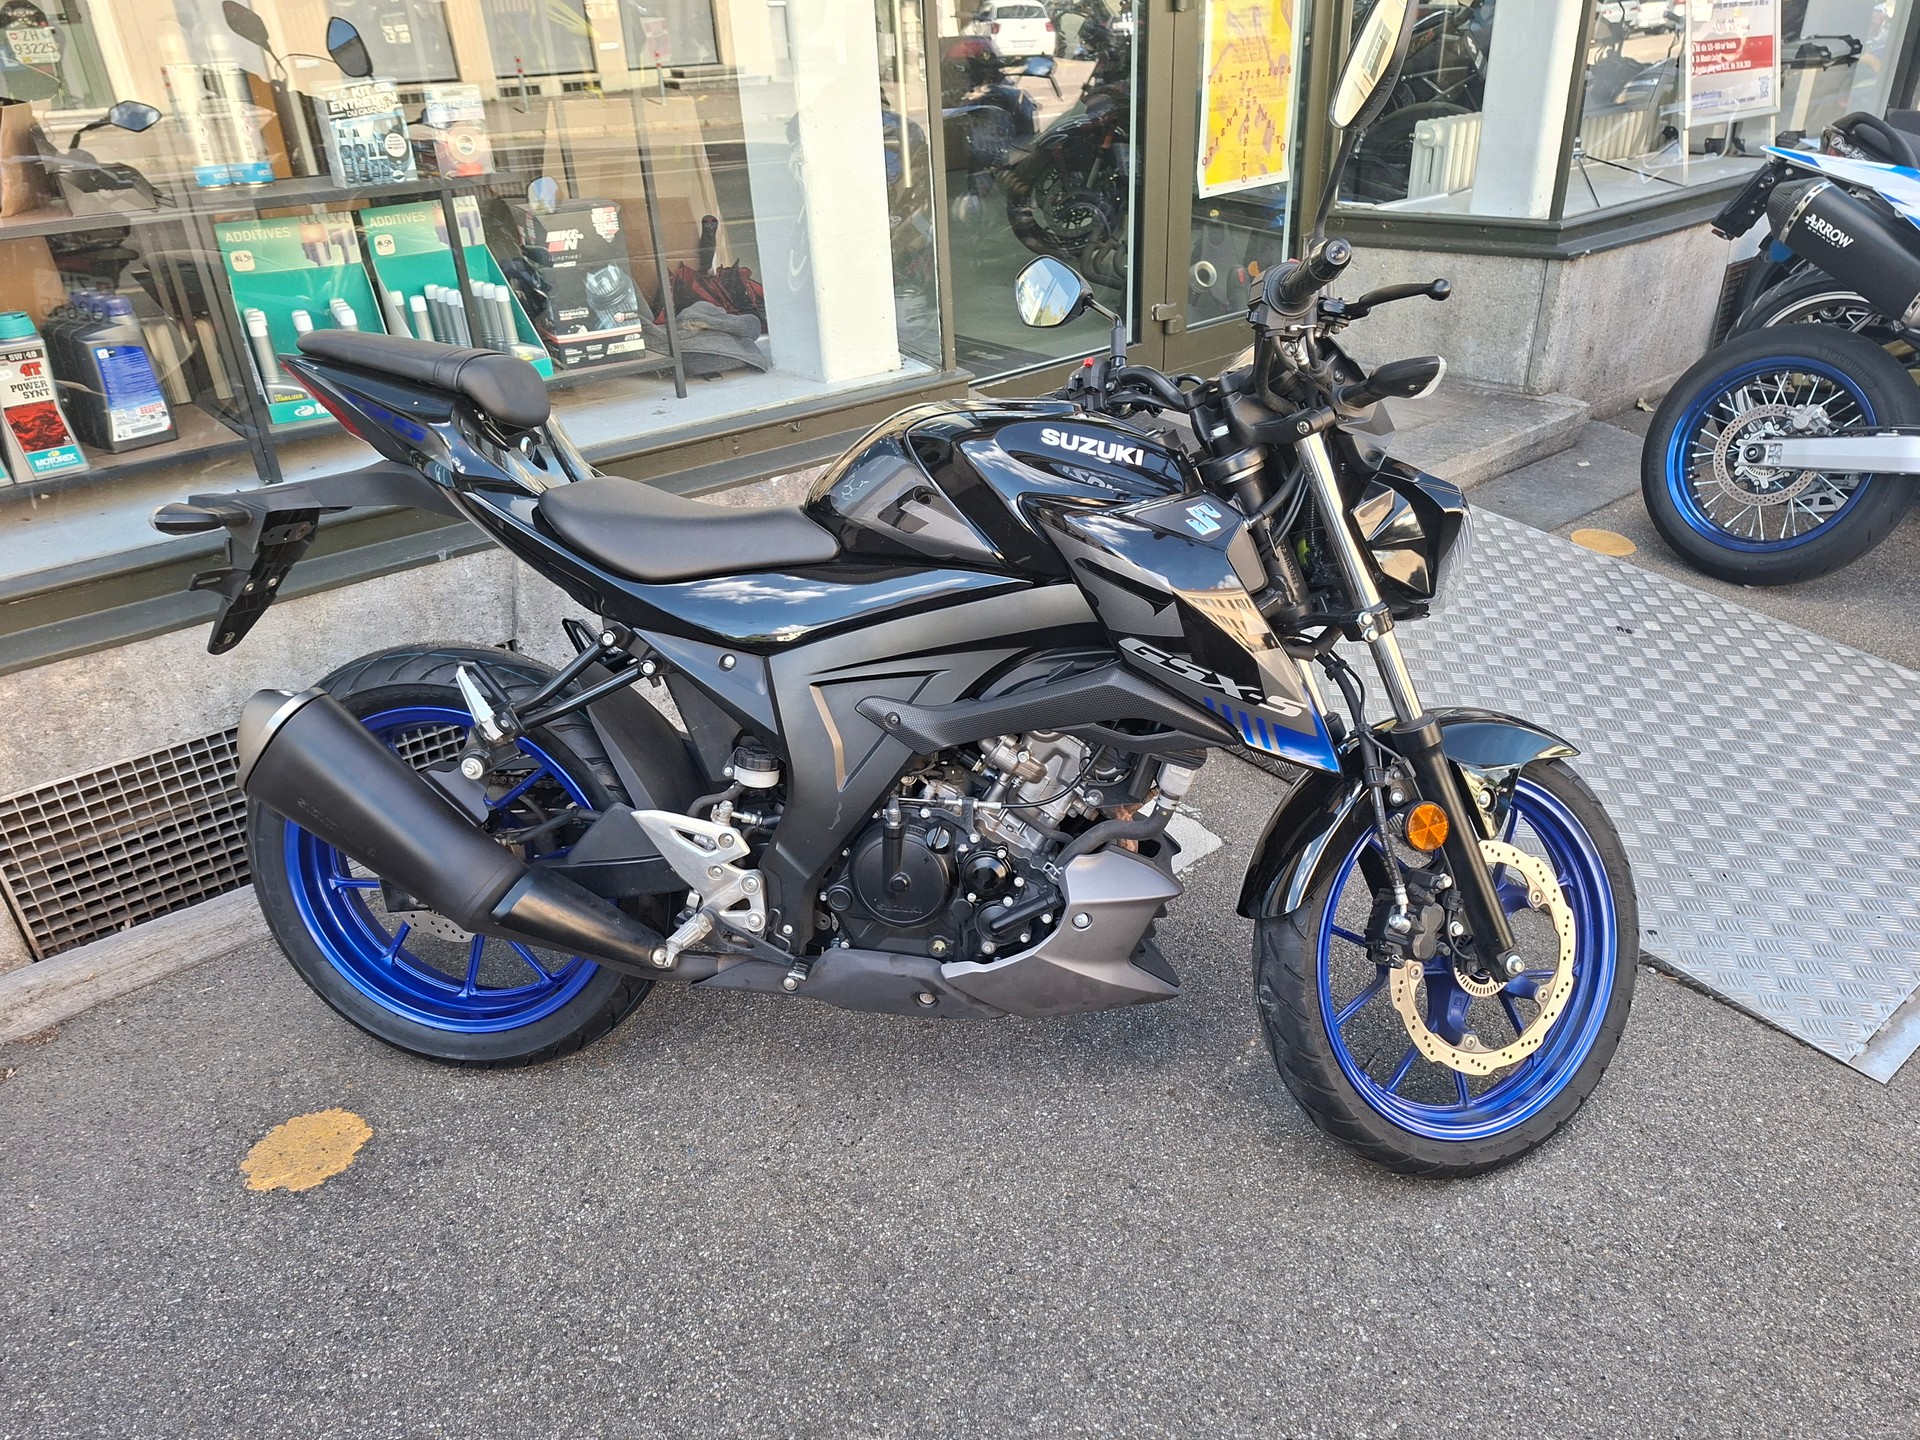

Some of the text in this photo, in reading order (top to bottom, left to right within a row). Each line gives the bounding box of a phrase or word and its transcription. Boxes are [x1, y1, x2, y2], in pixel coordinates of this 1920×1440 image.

[21, 30, 40, 41] ZH
[14, 42, 56, 55] 93225
[350, 85, 372, 98] KIT
[369, 211, 426, 229] ADDITIVES
[225, 226, 292, 244] ADDITIVES
[1804, 213, 1855, 248] ARROW
[20, 361, 42, 377] 4T
[10, 379, 48, 393] POWER
[22, 388, 50, 399] SYNT
[1040, 428, 1145, 466] SUZUKI
[34, 452, 77, 467] MOTOREX
[1118, 637, 1308, 718] GSX-S
